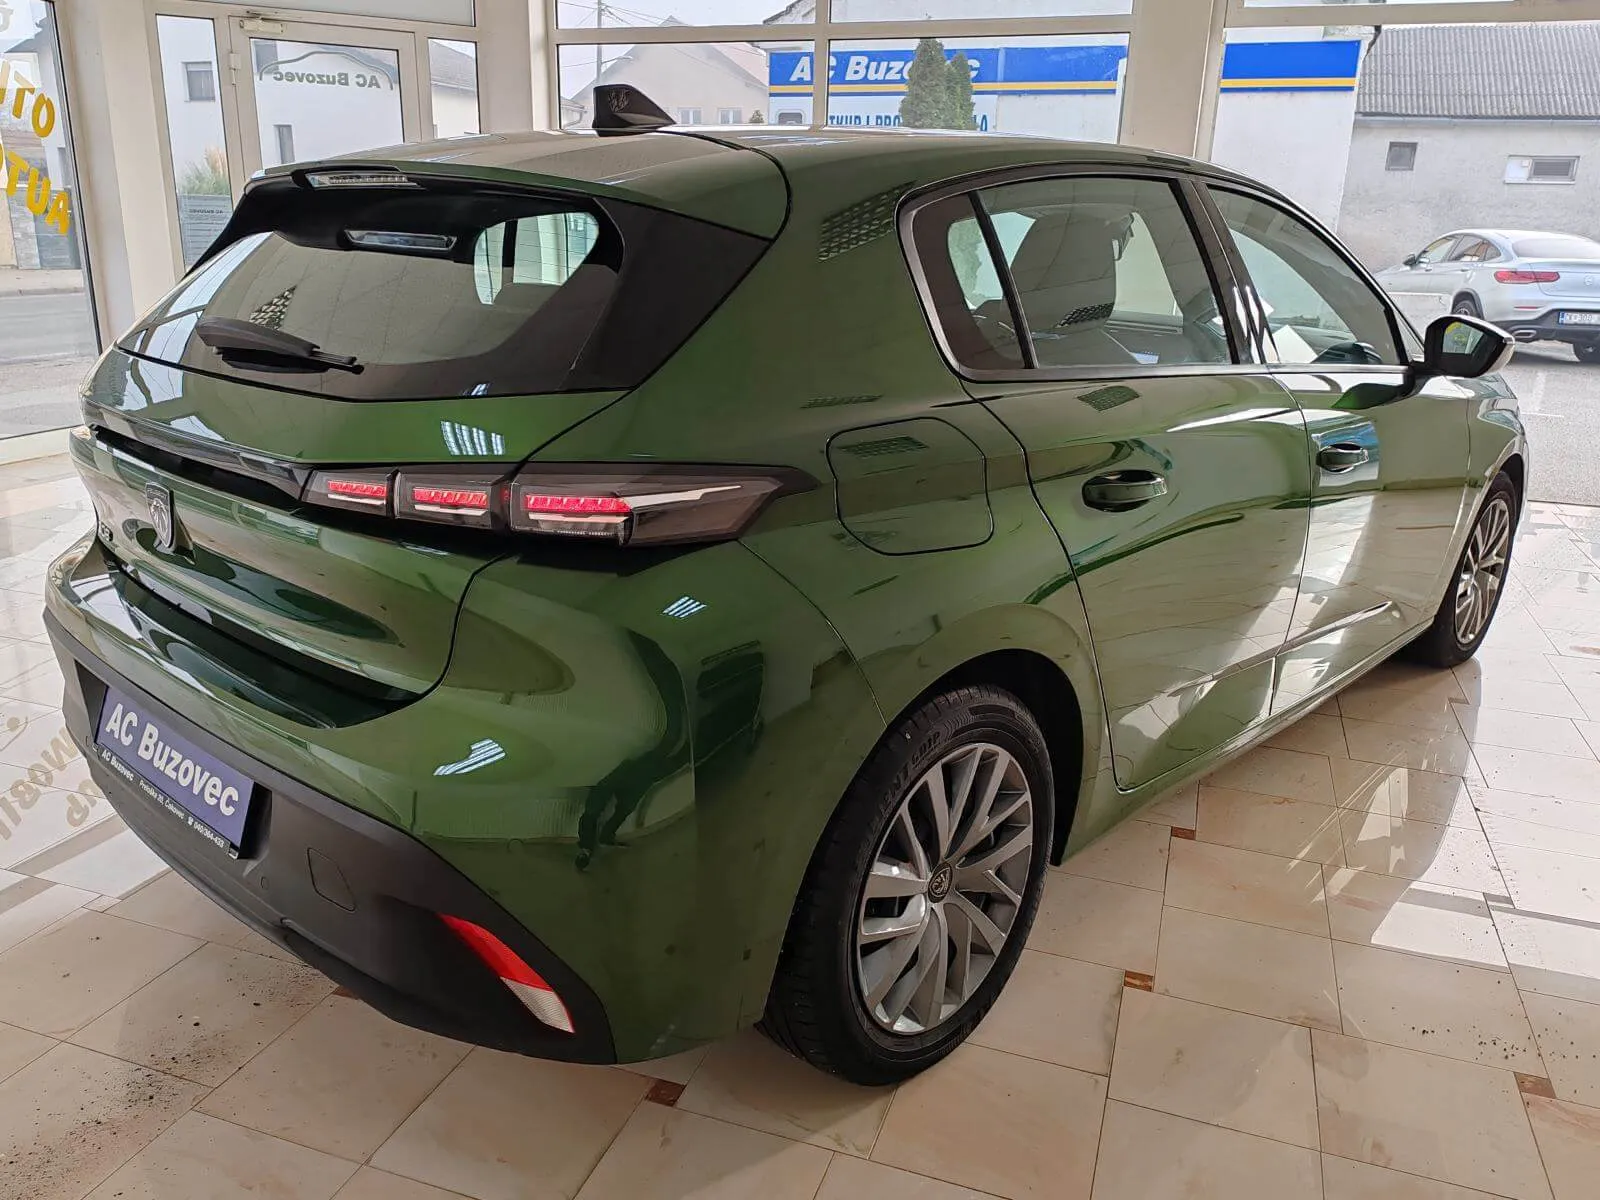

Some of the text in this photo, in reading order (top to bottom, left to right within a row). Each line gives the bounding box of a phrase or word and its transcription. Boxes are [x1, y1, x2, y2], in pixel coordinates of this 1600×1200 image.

[101, 749, 112, 762] AC
[105, 702, 240, 817] AC Buzovec
